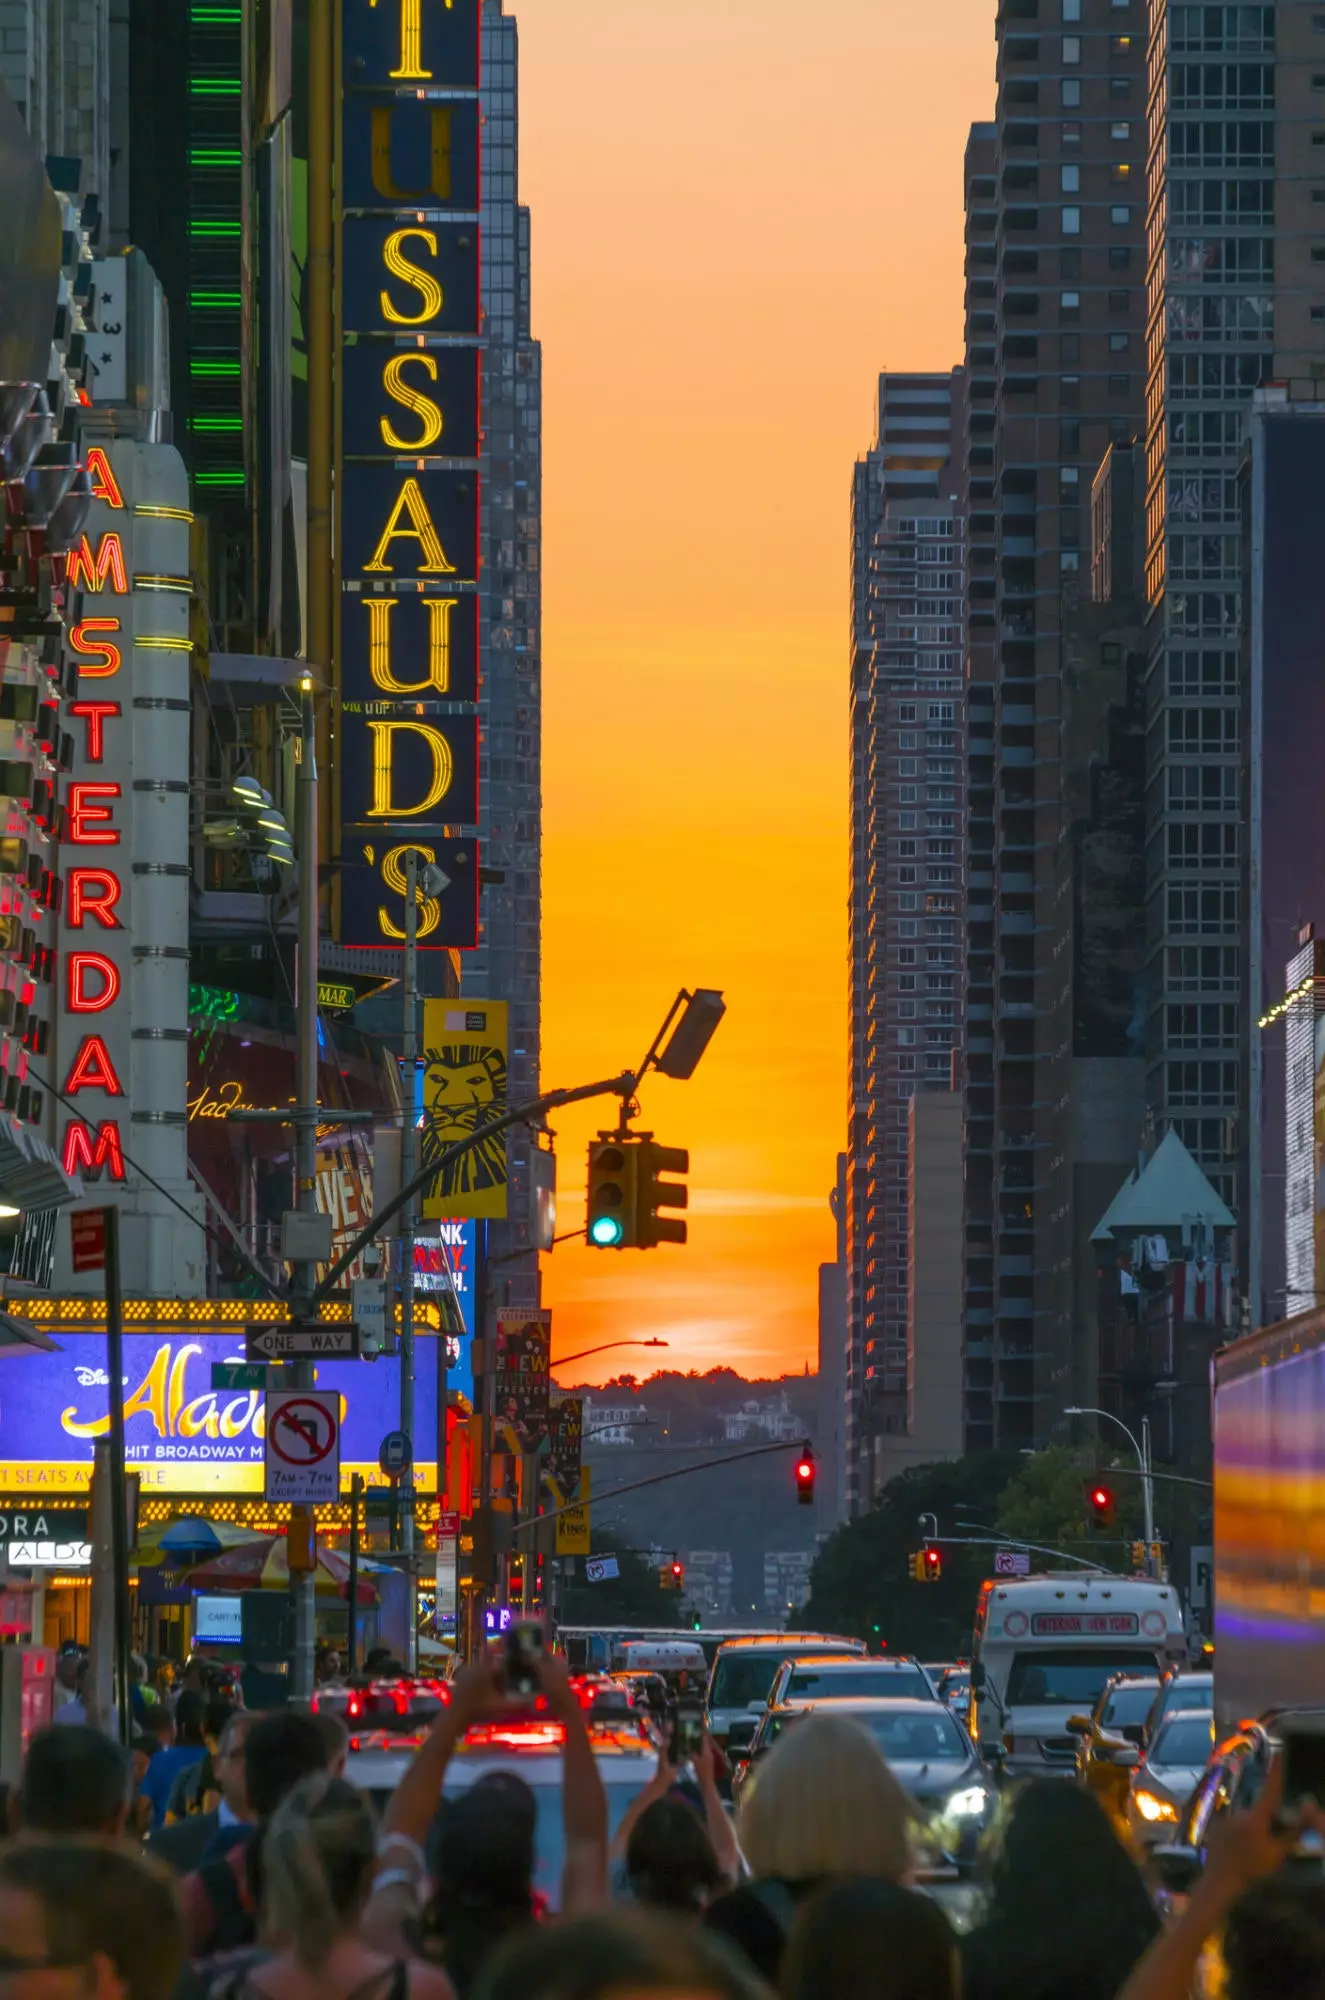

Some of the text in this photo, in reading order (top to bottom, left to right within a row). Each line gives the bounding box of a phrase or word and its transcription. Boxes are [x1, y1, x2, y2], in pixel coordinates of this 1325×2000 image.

[63, 446, 127, 1181] AMSTERDAM
[263, 1335, 344, 1350] ONE WAY
[506, 1354, 549, 1373] NEW
[225, 1367, 260, 1388] 7 AV
[125, 1445, 149, 1458] HIT
[155, 1445, 244, 1458] BROADWAY
[16, 1470, 67, 1484] SEATS
[271, 1470, 296, 1484] 7AM
[308, 1470, 333, 1485] 7PM
